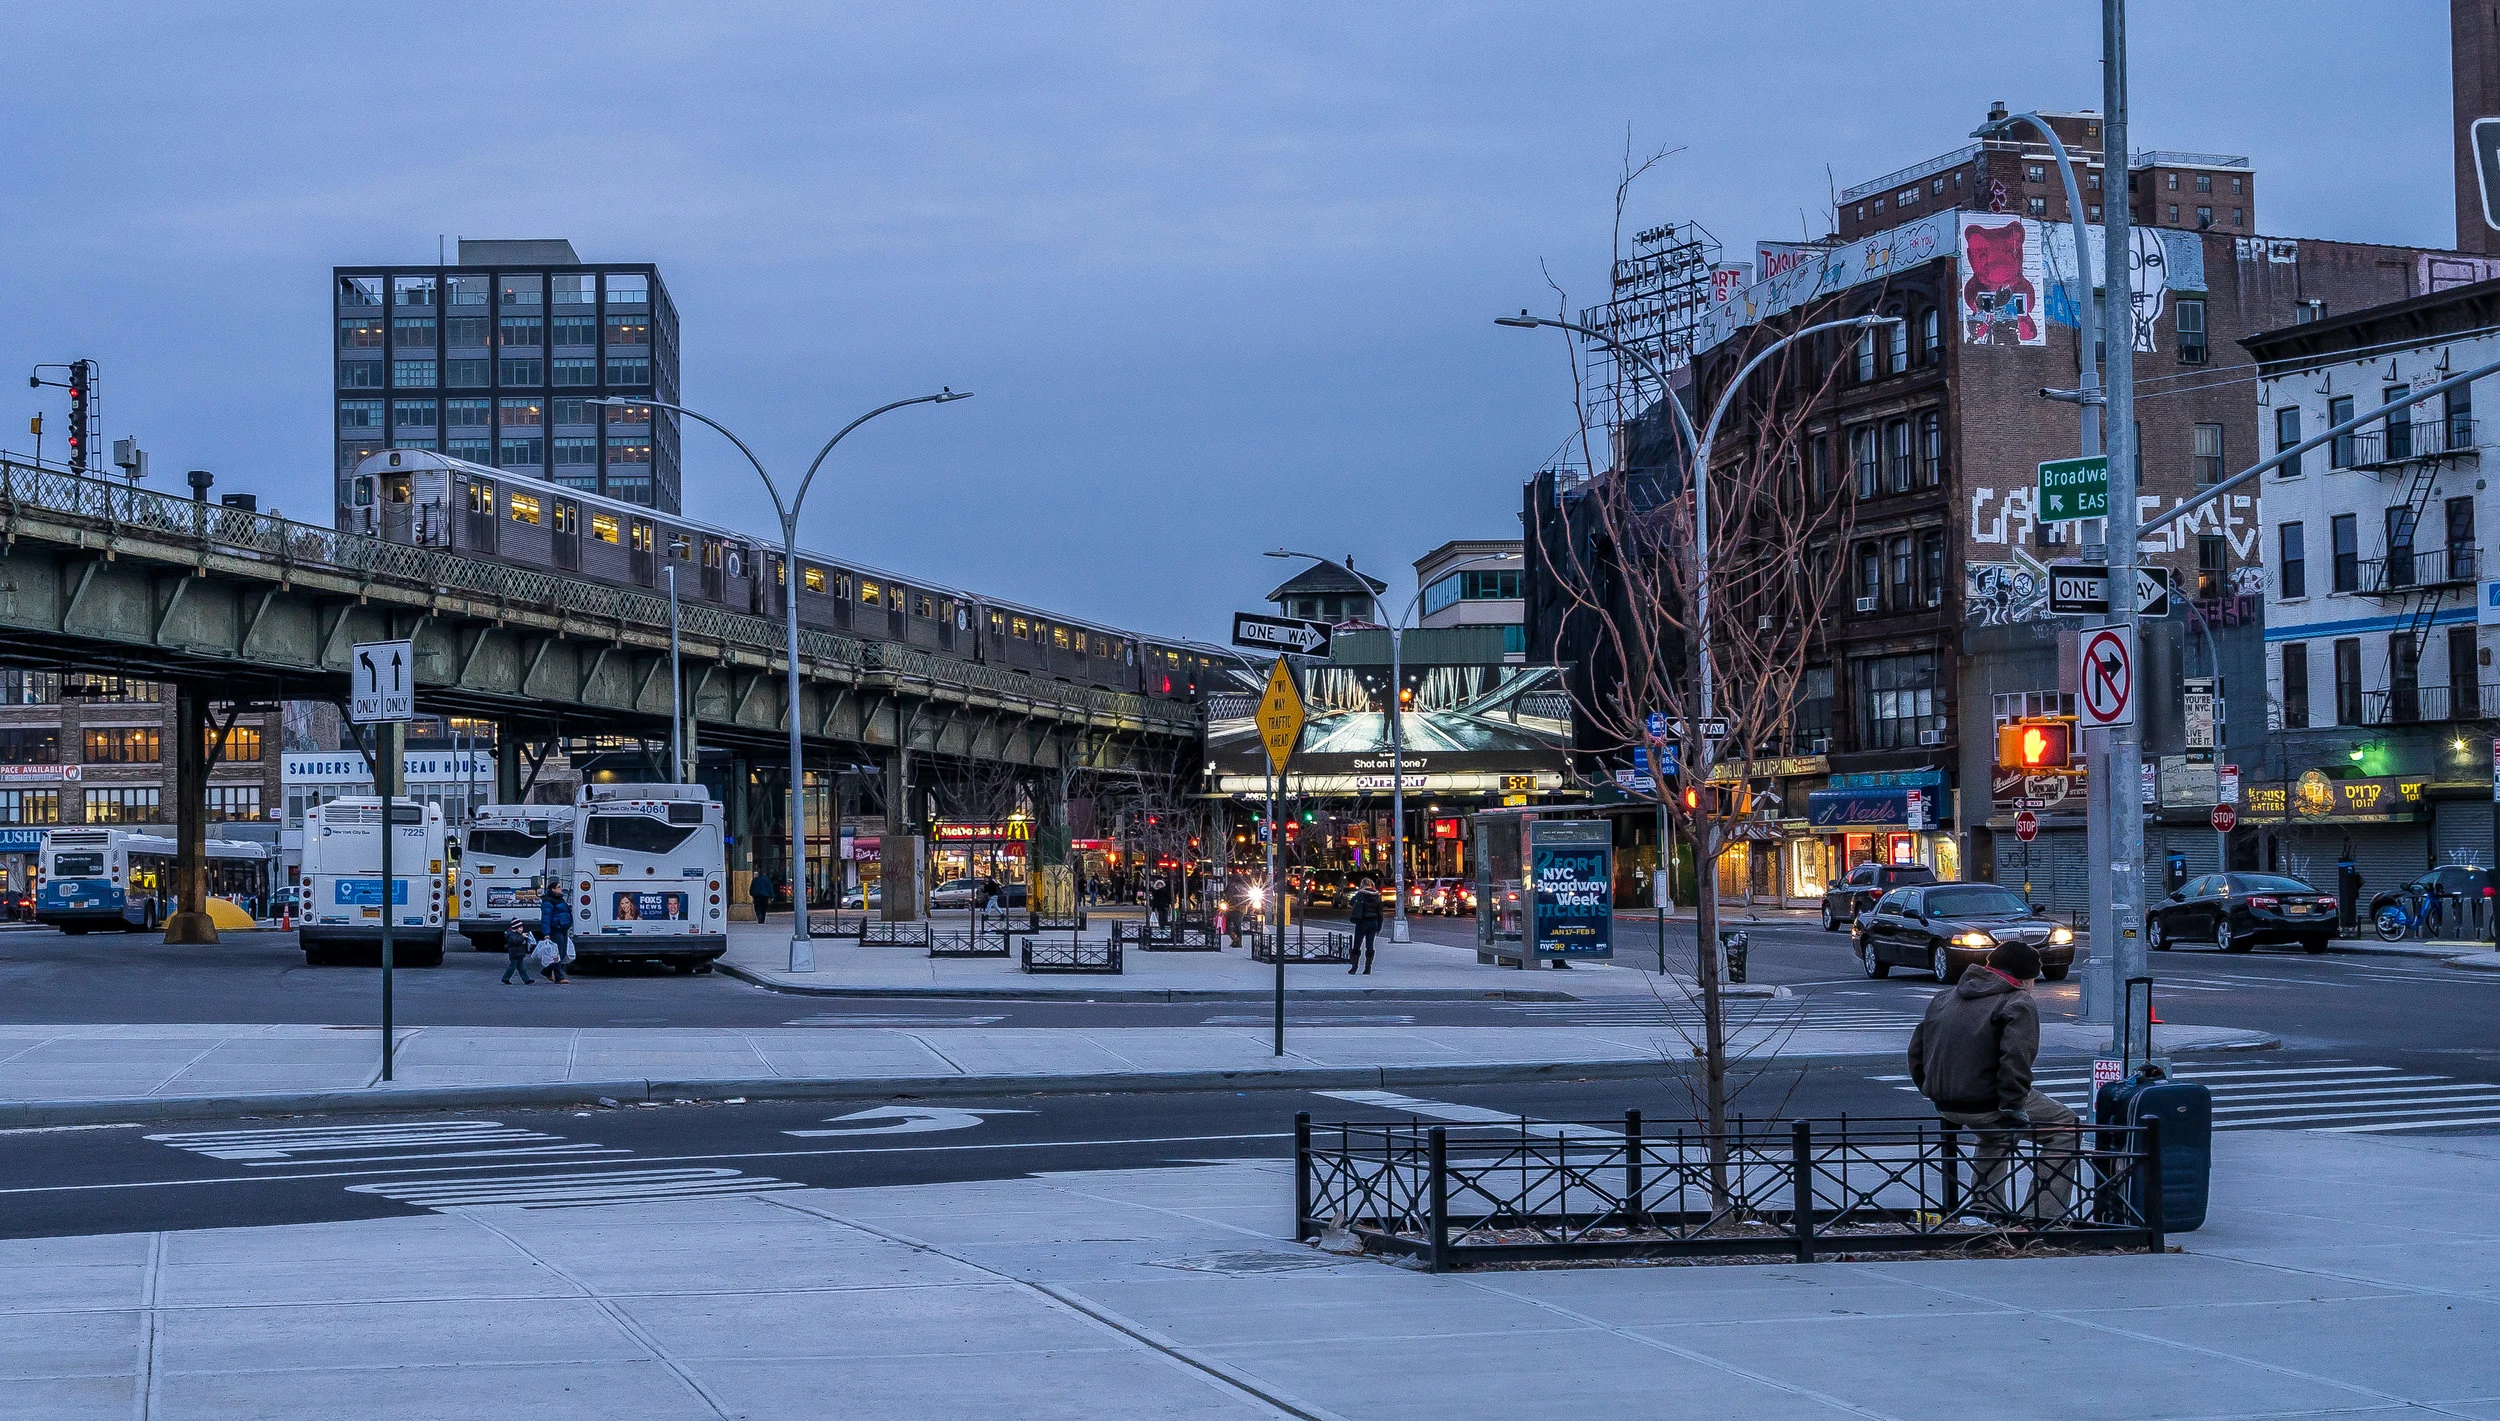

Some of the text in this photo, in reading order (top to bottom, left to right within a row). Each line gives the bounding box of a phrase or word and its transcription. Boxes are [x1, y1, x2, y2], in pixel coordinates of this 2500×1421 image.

[1636, 222, 1675, 246] THE
[1909, 235, 1932, 250] FOR YOU
[1610, 244, 1704, 294] CHASE
[1711, 270, 1741, 288] ART
[1715, 288, 1727, 302] IS
[1622, 332, 1693, 374] BANK
[2045, 467, 2108, 487] Broadwa
[2078, 492, 2108, 511] EAS
[2059, 581, 2155, 600] ONE AY
[1247, 624, 1317, 646] ONE WAY
[1274, 680, 1286, 693] TWO
[356, 697, 409, 714] ONLY ONLY
[1274, 697, 1285, 710] WAY
[2185, 695, 2211, 704] YOU'RE
[2185, 703, 2211, 712] IN NYC.
[1268, 715, 1291, 730] TRAFFIC
[2186, 729, 2202, 737] LIVE
[1270, 734, 1289, 747] AHEAD
[2186, 738, 2202, 746] LIKE
[22, 765, 63, 774] AVAILABLE
[289, 761, 350, 775] SANDER'S
[444, 760, 487, 773] HOUSE
[1354, 759, 1375, 768] Shot
[1420, 758, 1428, 768] 7
[68, 769, 77, 778] W
[1357, 776, 1425, 788] OUTFONT
[1508, 776, 1537, 790] 5:21
[2248, 788, 2286, 802] Krausz
[639, 805, 666, 814] 4060
[1836, 800, 1897, 820] Nails
[2251, 802, 2285, 811] HATTERS
[2213, 812, 2234, 823] STOP
[402, 828, 425, 837] 7225
[2018, 820, 2036, 832] STOP
[1554, 857, 1589, 872] FOR
[1543, 867, 1575, 881] NYC
[1537, 879, 1608, 894] Broadway
[1555, 892, 1600, 906] Week
[1538, 902, 1608, 917] TICKETS
